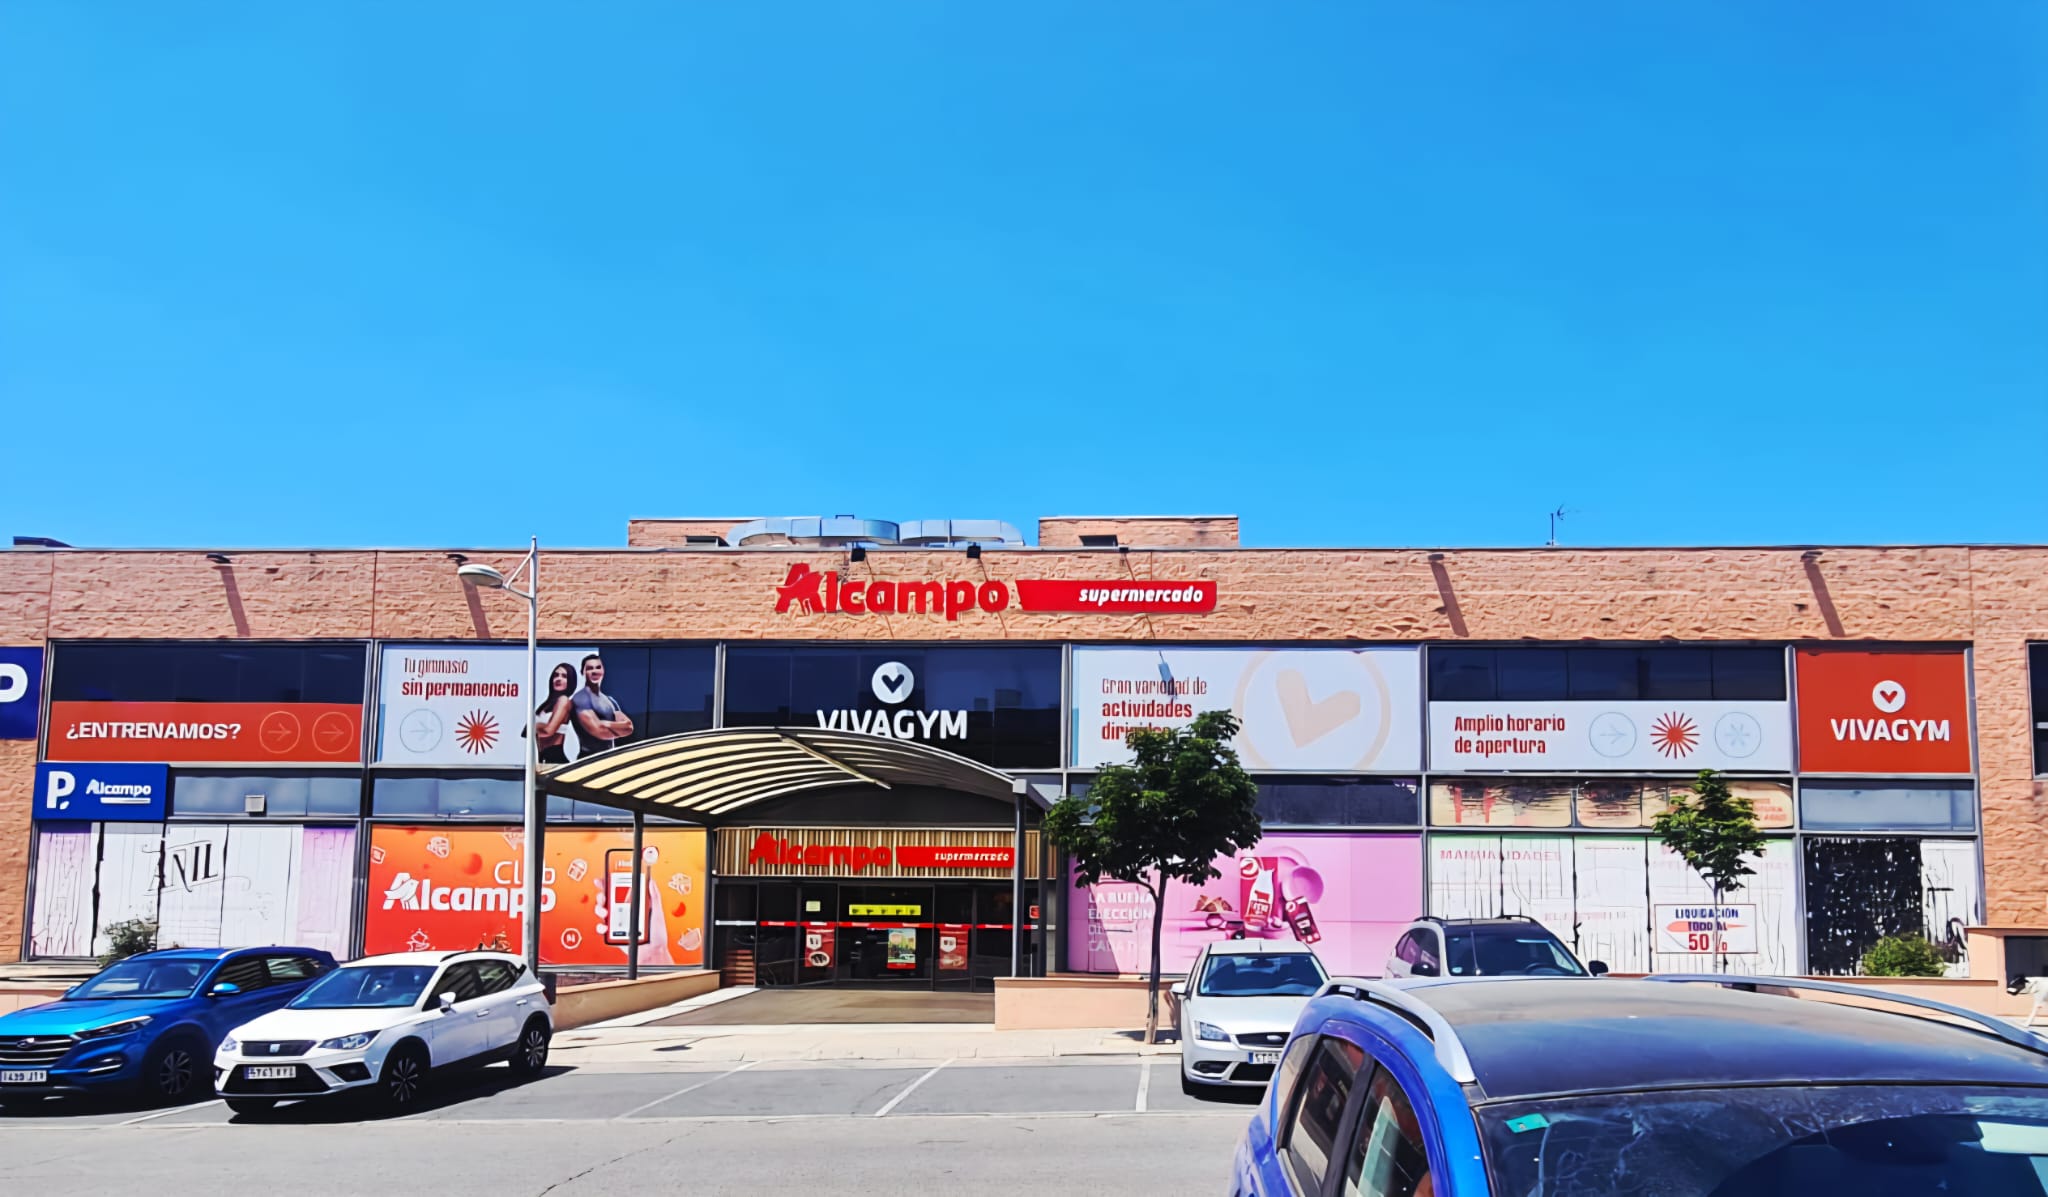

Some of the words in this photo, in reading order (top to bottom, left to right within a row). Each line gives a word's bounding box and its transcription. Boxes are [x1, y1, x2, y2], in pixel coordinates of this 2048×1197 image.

[775, 563, 1009, 621] Alcampo
[1078, 585, 1204, 605] supermercado
[418, 657, 469, 678] gimnasio
[402, 678, 423, 696] sin
[425, 679, 519, 701] permanencia
[1102, 678, 1132, 694] Gran
[1193, 676, 1207, 694] de
[1102, 699, 1193, 717] actividades
[66, 721, 242, 740] ¿ENTRENAMOS?
[816, 708, 968, 740] VIVAGYM
[1454, 714, 1504, 736] Amplio
[1506, 713, 1566, 732] horario
[1830, 718, 1950, 741] VIVAGYM
[1454, 735, 1472, 754] de
[1475, 737, 1546, 758] apertura
[86, 779, 152, 796] Alcampo
[750, 831, 893, 872] Alcampo
[494, 860, 557, 885] Clb
